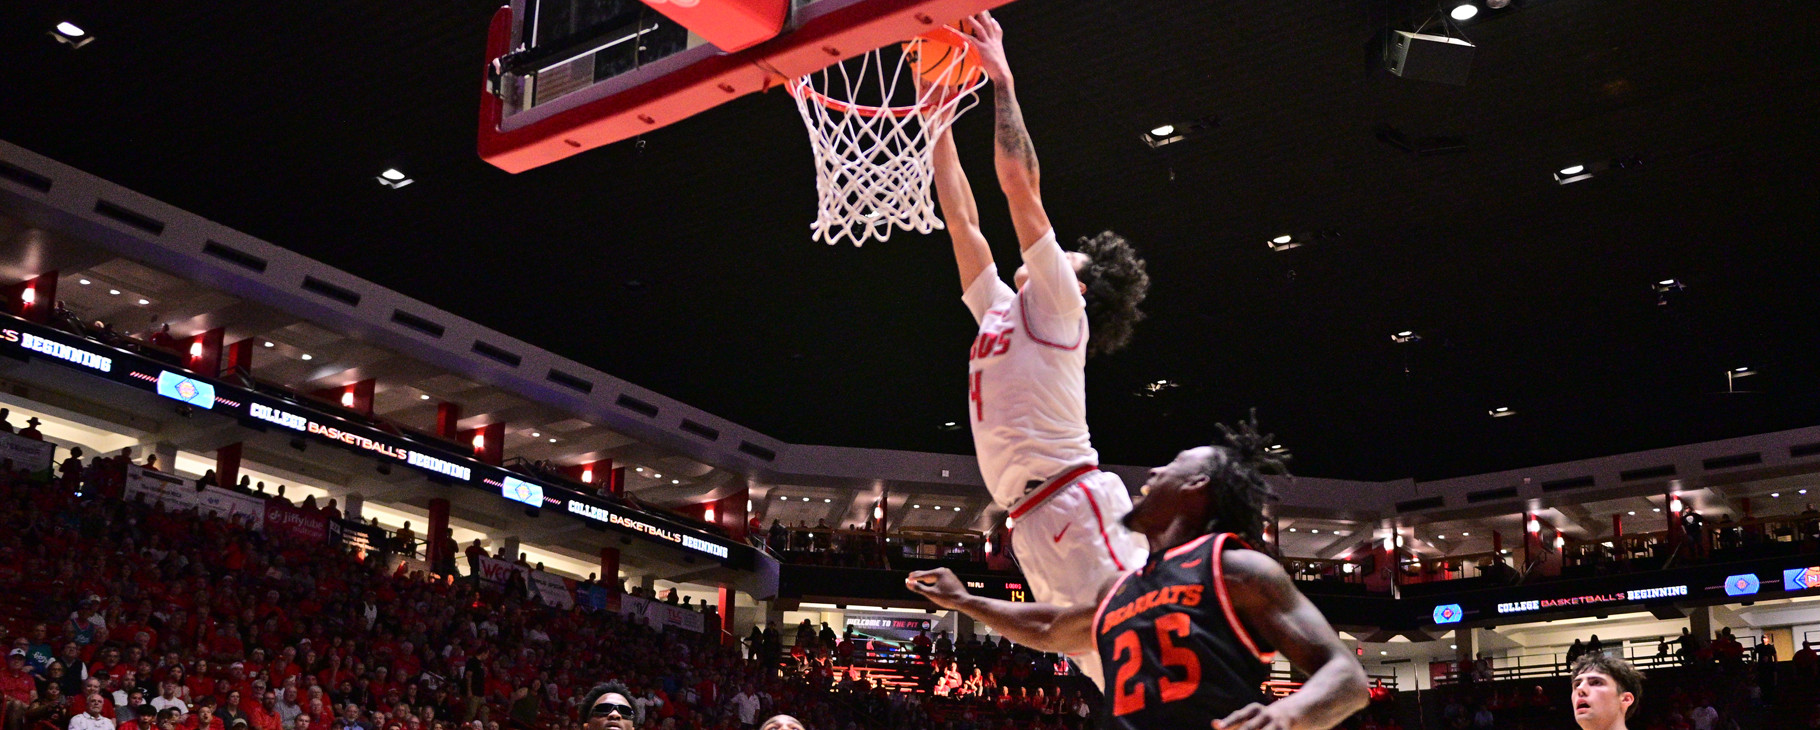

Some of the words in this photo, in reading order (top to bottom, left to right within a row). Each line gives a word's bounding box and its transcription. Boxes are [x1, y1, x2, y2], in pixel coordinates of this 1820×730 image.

[21, 332, 112, 373] BEGINNING
[250, 402, 307, 432] COLLEGE
[308, 421, 407, 460] BASKETBALL'S
[407, 450, 471, 481] BEGINNING
[567, 499, 609, 522] COLLEGE
[609, 513, 682, 543] BASKETBALL'S
[682, 534, 728, 559] BEGINNING
[1011, 590, 1025, 602] 14
[1100, 584, 1205, 635] BEARKATS
[1497, 599, 1540, 614] COLLEGE
[1541, 592, 1626, 608] BASKETBALL'S
[1627, 585, 1688, 600] BEGINNING
[846, 618, 880, 627] WELCOME
[882, 619, 891, 627] TO
[893, 620, 905, 628] THE
[1112, 611, 1202, 717] 25
